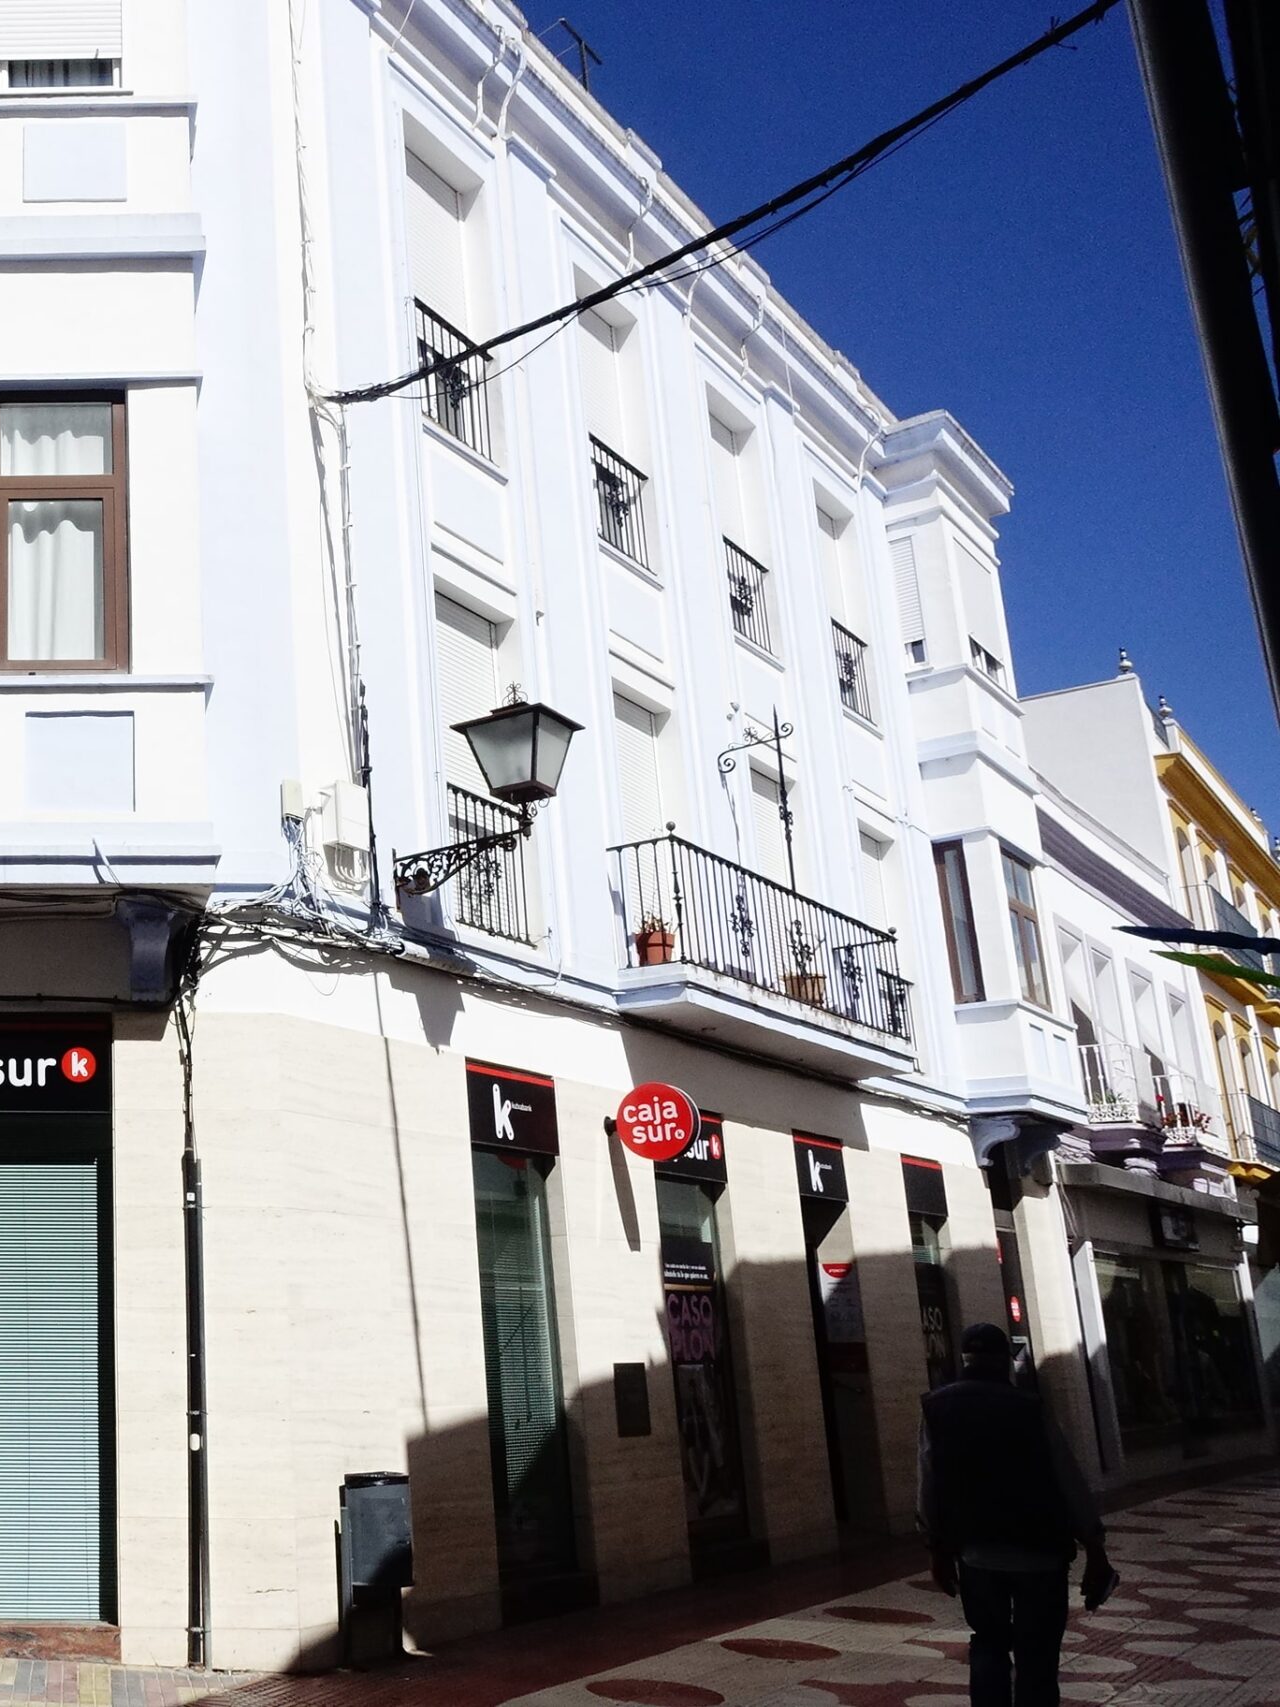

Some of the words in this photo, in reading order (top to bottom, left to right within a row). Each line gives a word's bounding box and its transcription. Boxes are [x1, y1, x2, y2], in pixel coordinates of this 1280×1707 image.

[71, 1052, 89, 1077] k
[623, 1096, 678, 1125] caja
[632, 1122, 677, 1144] sur
[667, 1293, 713, 1327] CASO
